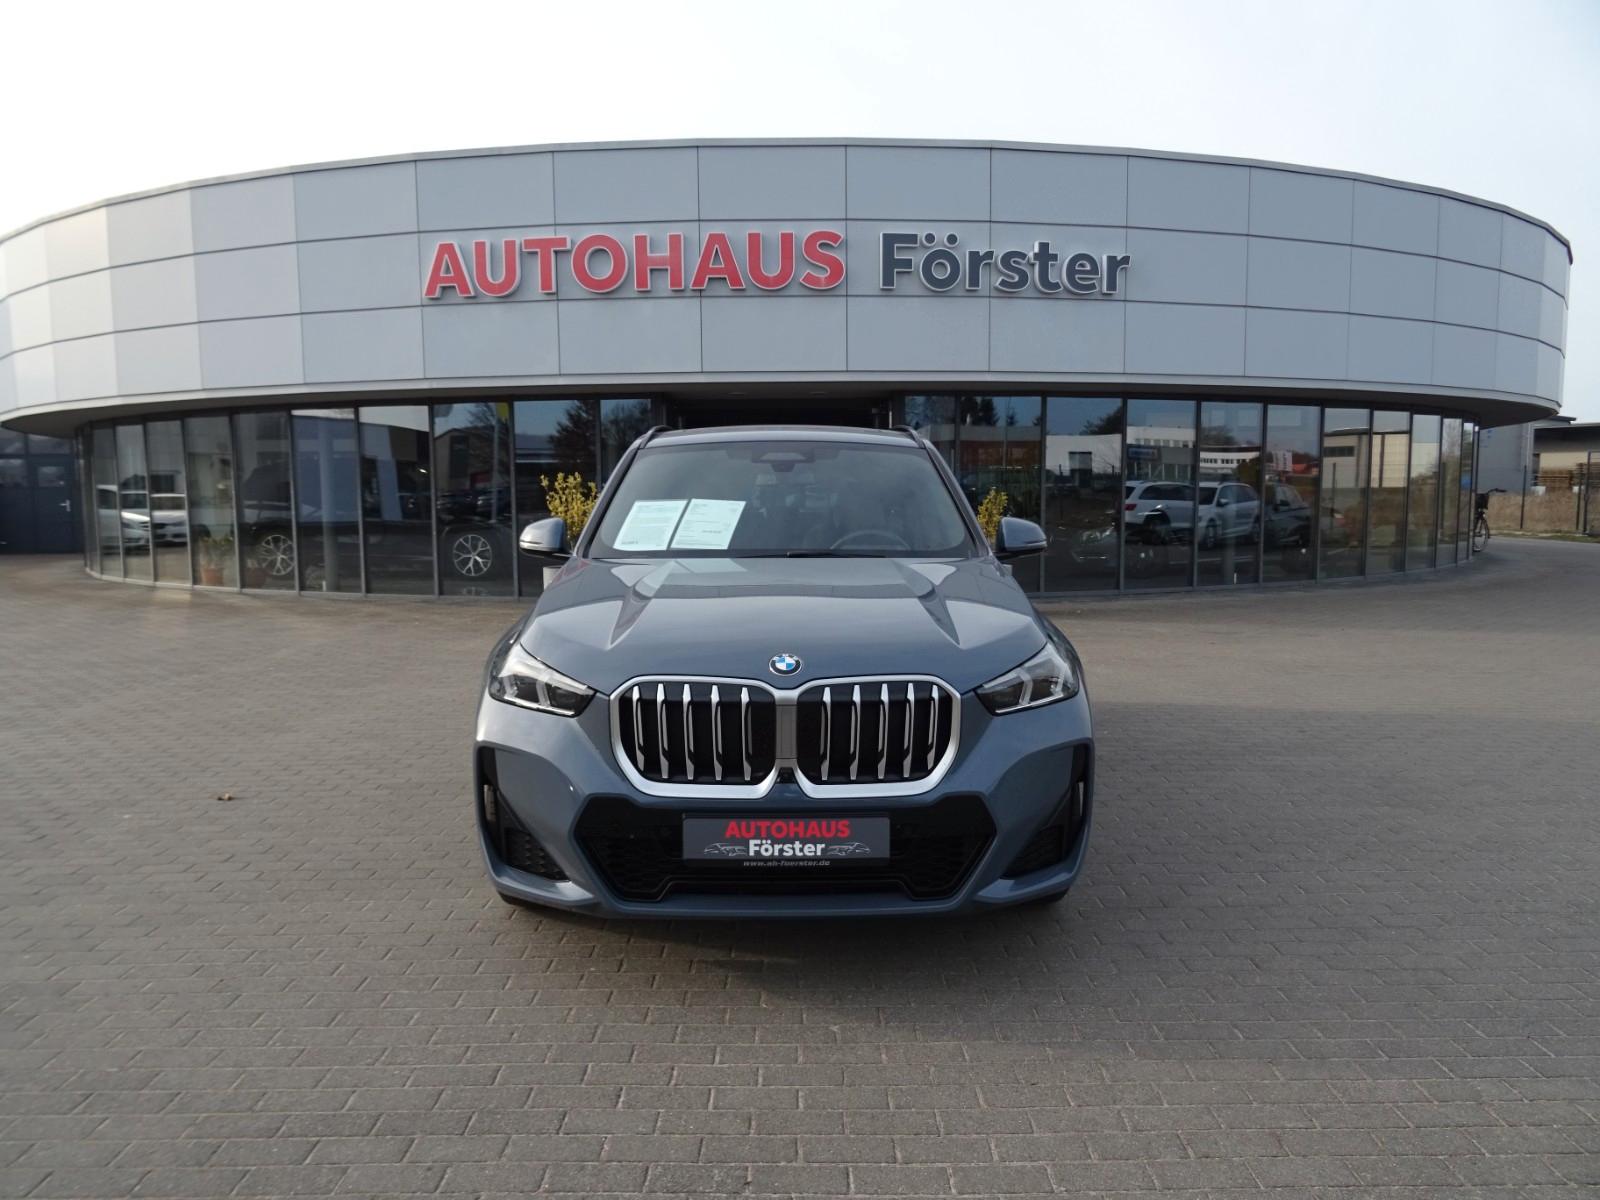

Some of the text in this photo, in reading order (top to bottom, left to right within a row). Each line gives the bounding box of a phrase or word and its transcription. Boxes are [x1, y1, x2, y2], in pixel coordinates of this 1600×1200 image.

[424, 230, 1131, 299] AUTOHAUS Förster
[725, 820, 850, 838] AUTOHAUS
[748, 839, 826, 856] Förster
